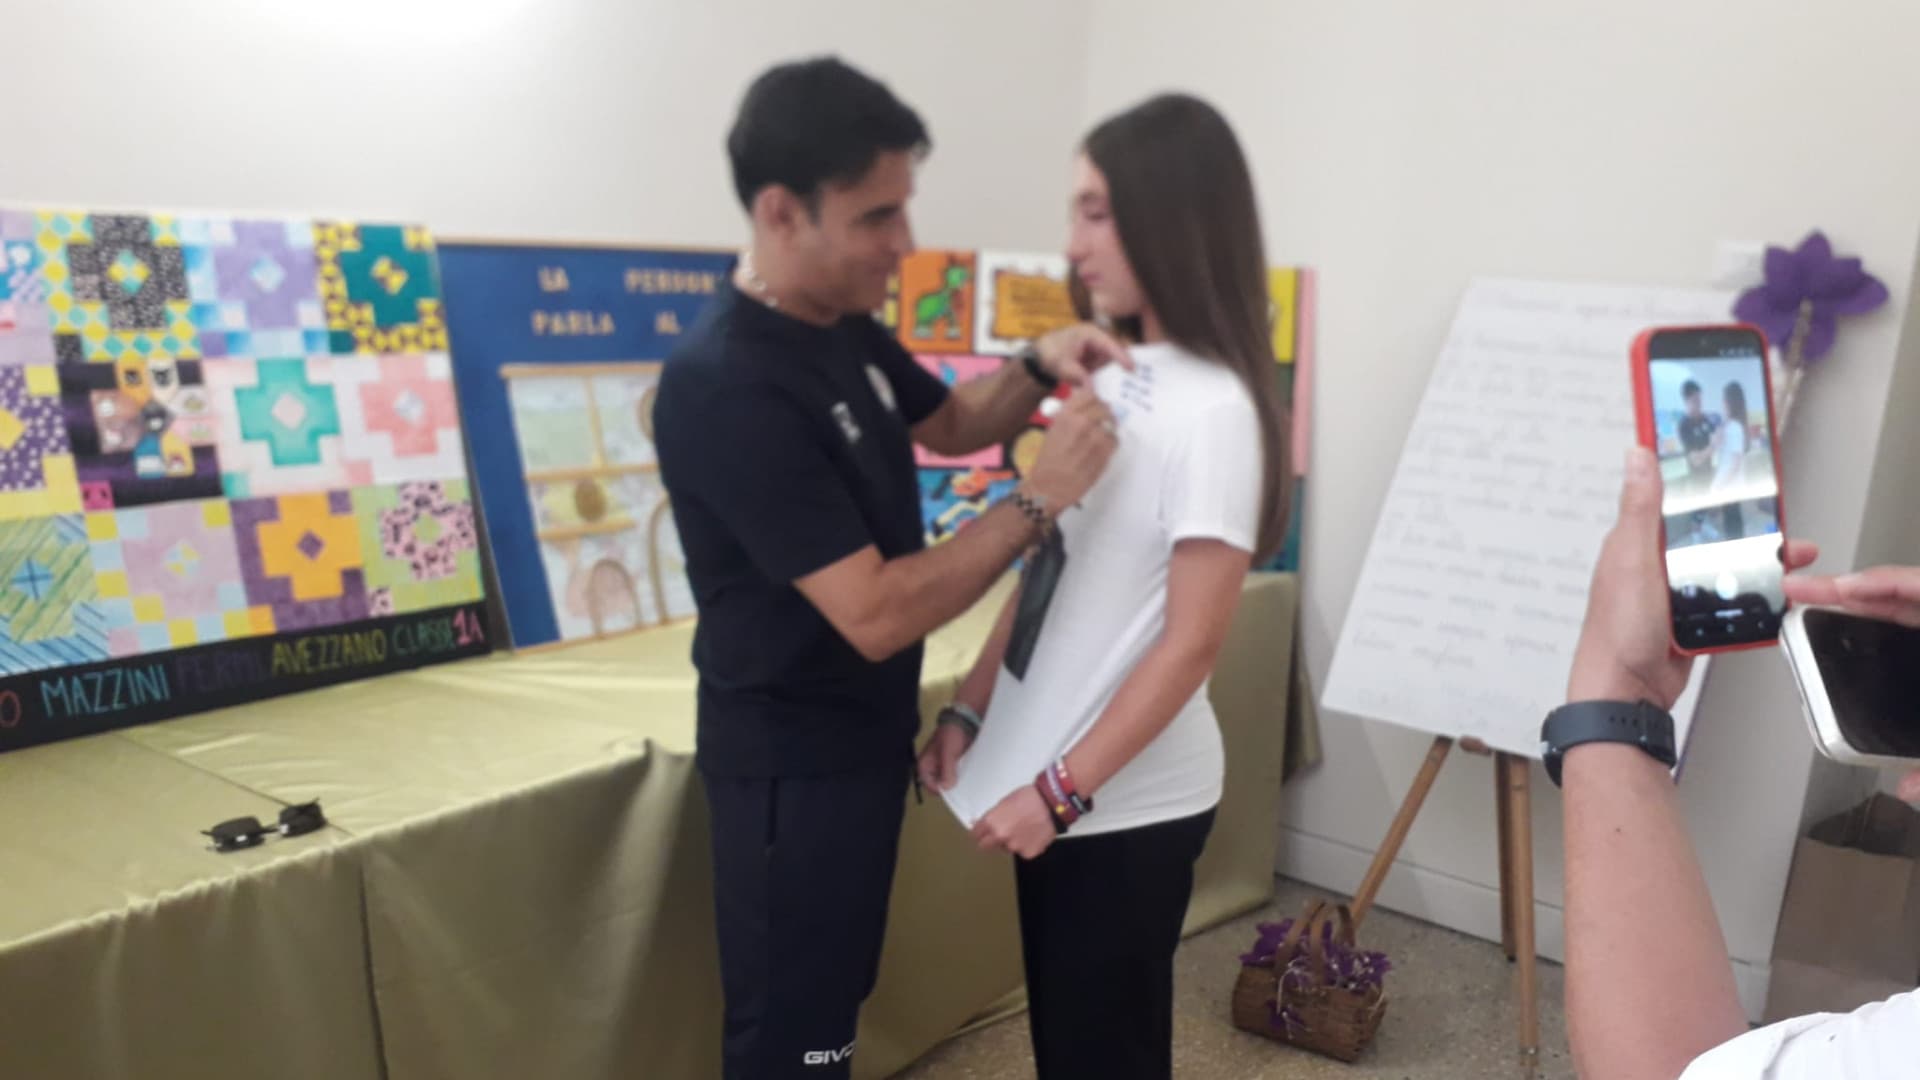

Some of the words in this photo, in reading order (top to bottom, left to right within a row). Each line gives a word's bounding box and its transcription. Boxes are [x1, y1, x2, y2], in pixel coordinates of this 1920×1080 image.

[625, 268, 717, 294] PERSON
[532, 309, 615, 336] PARLA
[40, 664, 171, 718] MAZZINI
[272, 629, 387, 676] AVEZZANO
[392, 617, 456, 656] CLASSE
[453, 608, 485, 645] 1A
